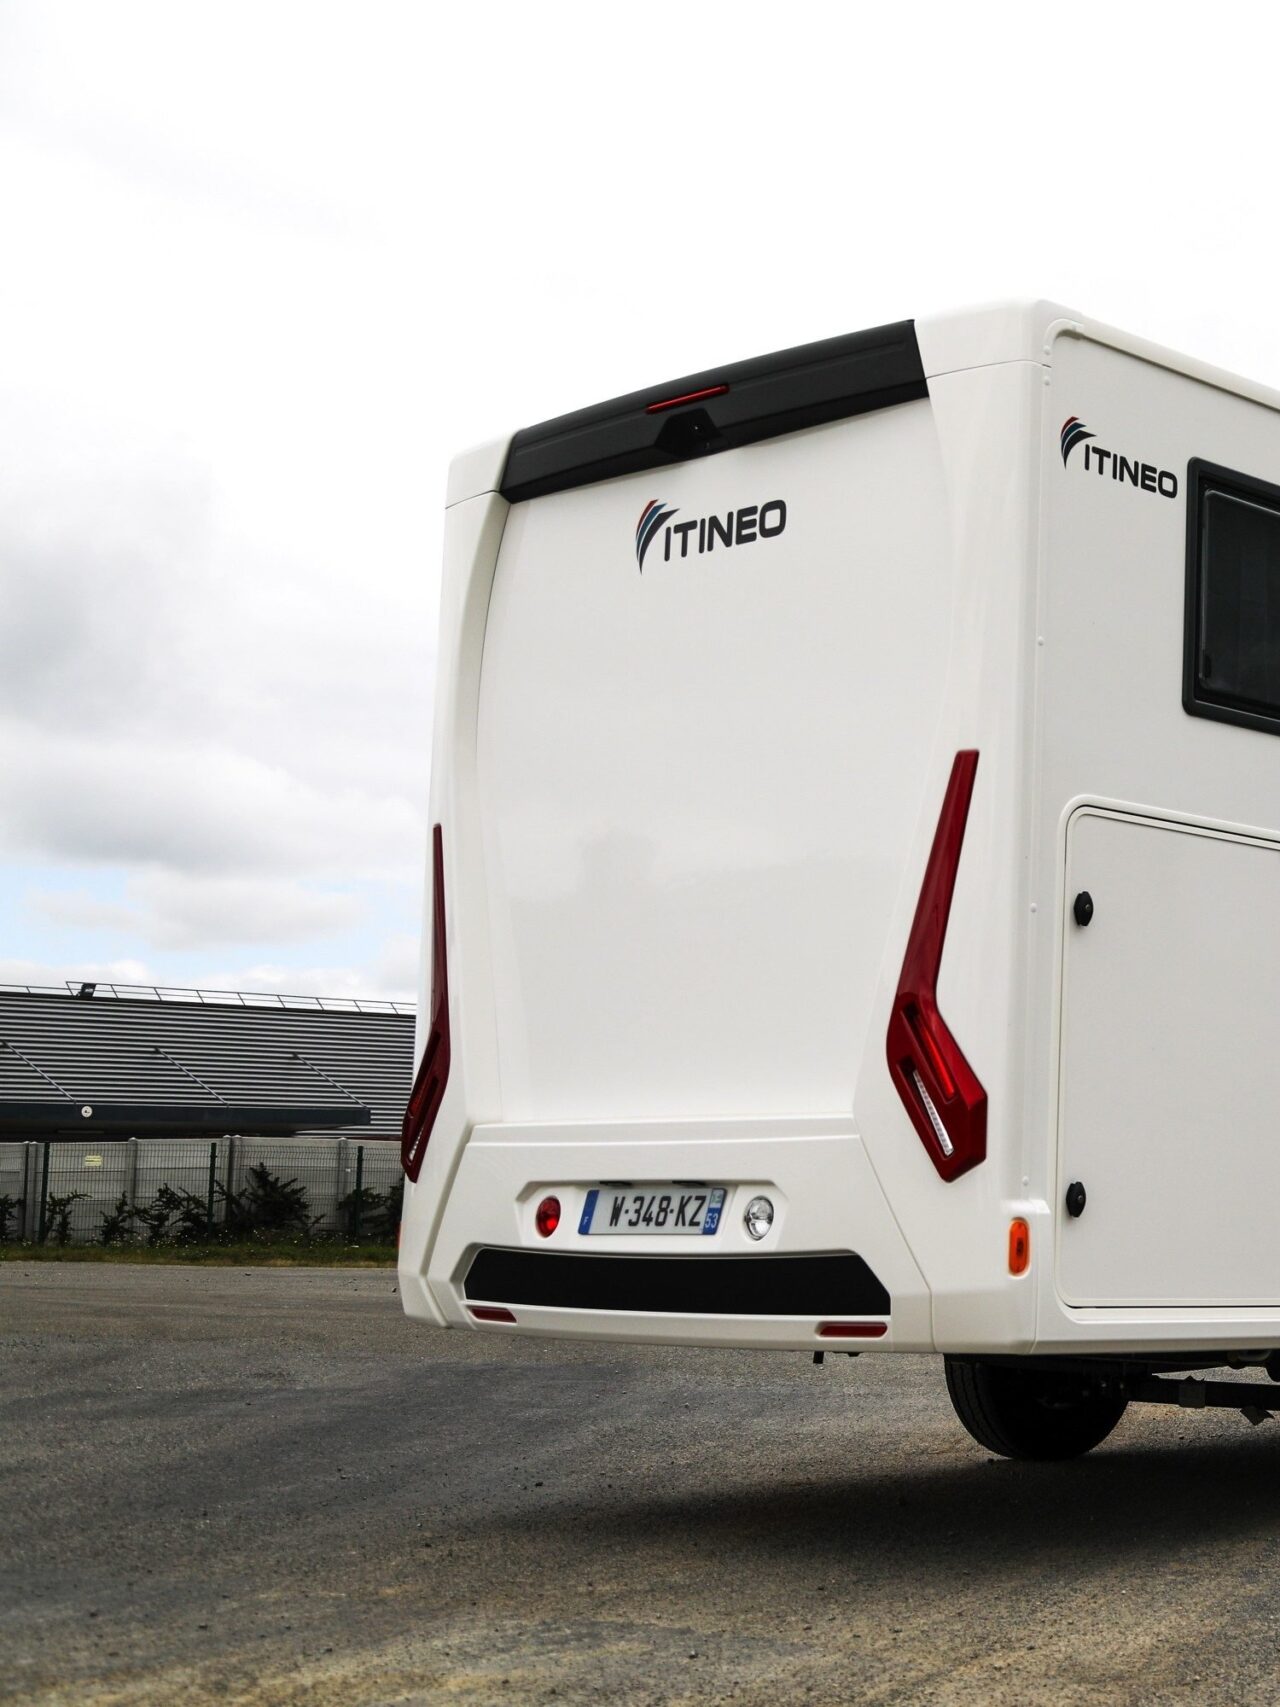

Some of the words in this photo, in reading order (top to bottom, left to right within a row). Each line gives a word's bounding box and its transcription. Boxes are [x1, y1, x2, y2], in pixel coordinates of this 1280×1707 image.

[1084, 444, 1178, 499] ITINEO
[664, 499, 787, 562] ITINEO
[704, 1212, 719, 1229] 53
